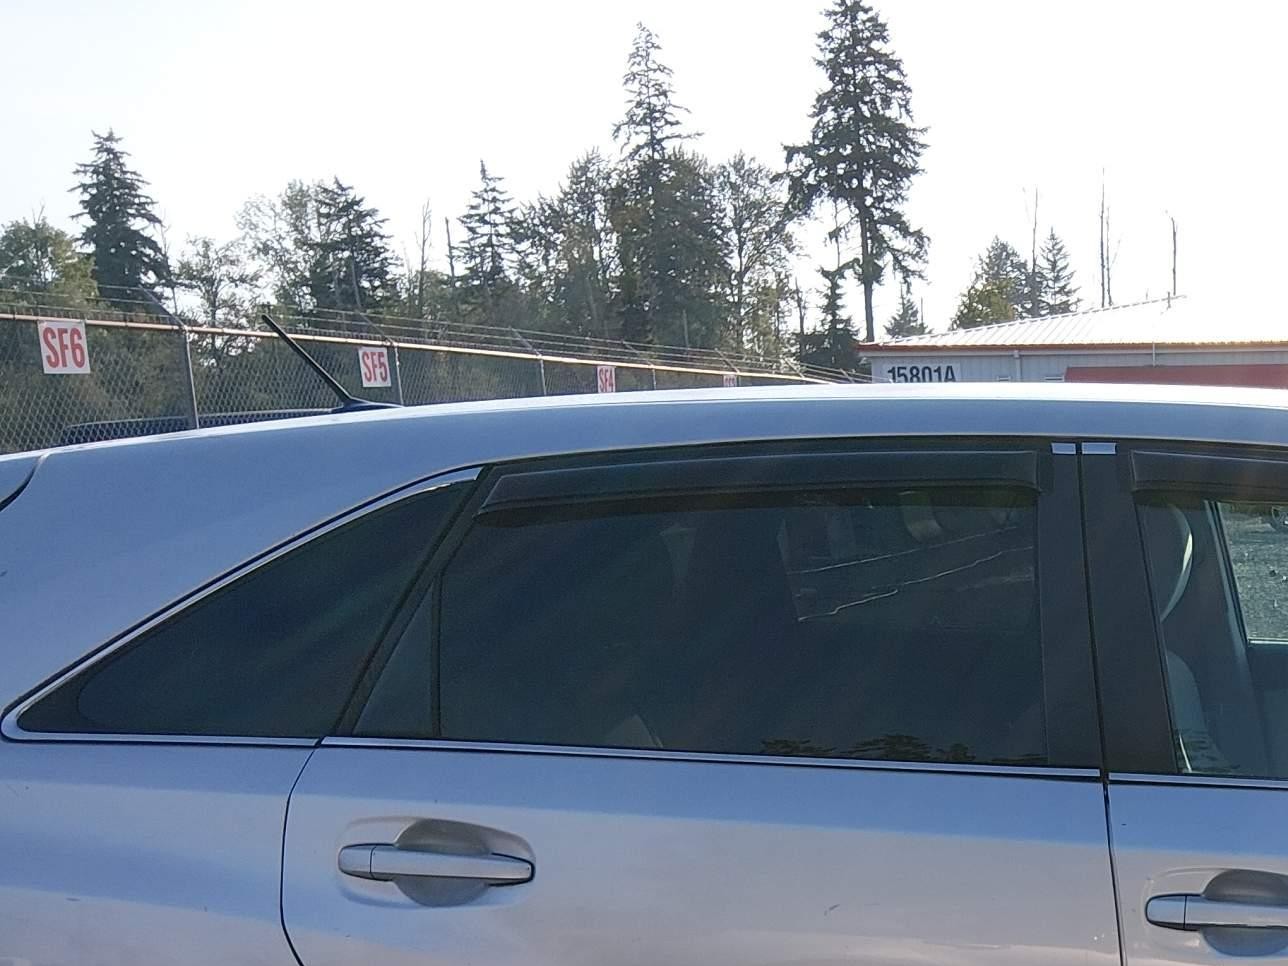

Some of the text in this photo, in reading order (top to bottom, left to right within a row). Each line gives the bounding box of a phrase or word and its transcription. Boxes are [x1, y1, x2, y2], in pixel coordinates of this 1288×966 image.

[42, 327, 86, 369] SF6
[361, 351, 388, 382] SF5
[887, 365, 957, 383] 15801A
